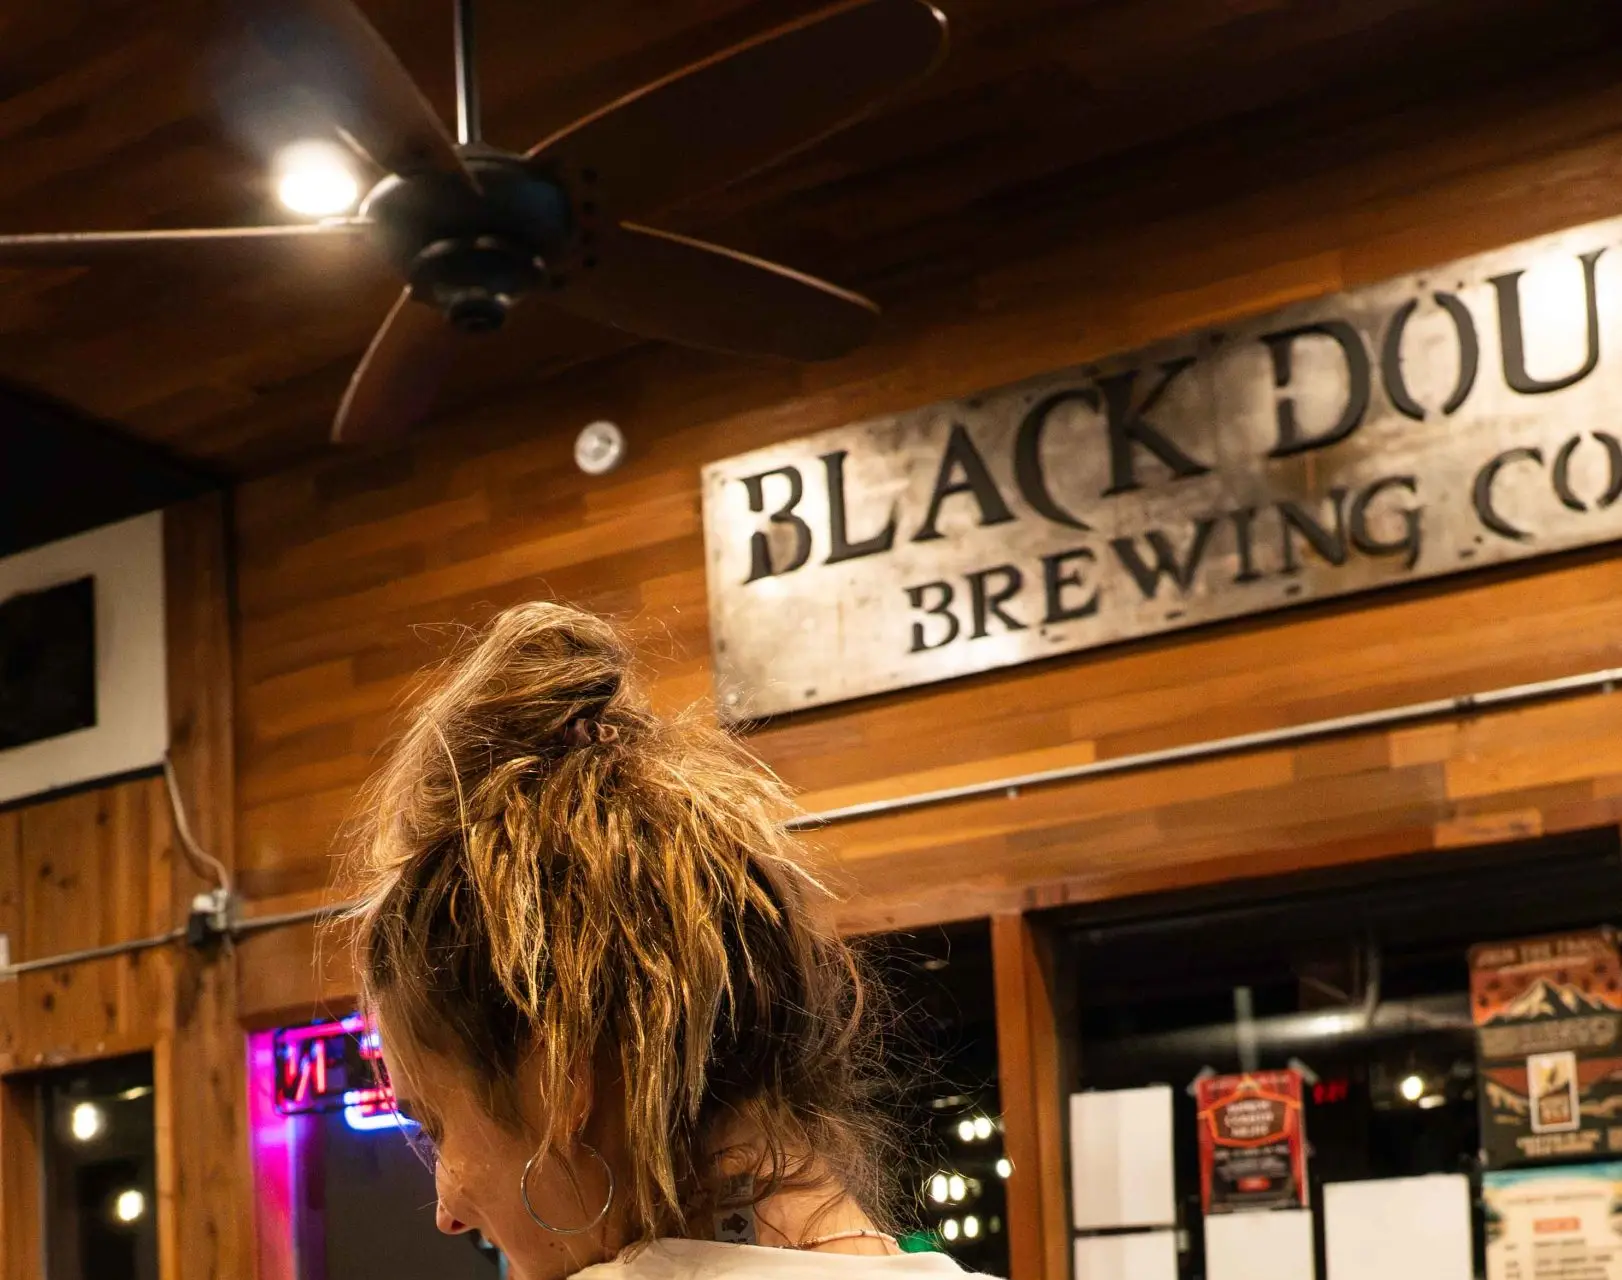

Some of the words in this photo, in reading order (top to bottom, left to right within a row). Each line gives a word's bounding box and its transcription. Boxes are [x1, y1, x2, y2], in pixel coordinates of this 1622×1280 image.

[741, 356, 1211, 586] BLACK
[1260, 246, 1609, 459] DOU
[908, 473, 1421, 655] BREWING
